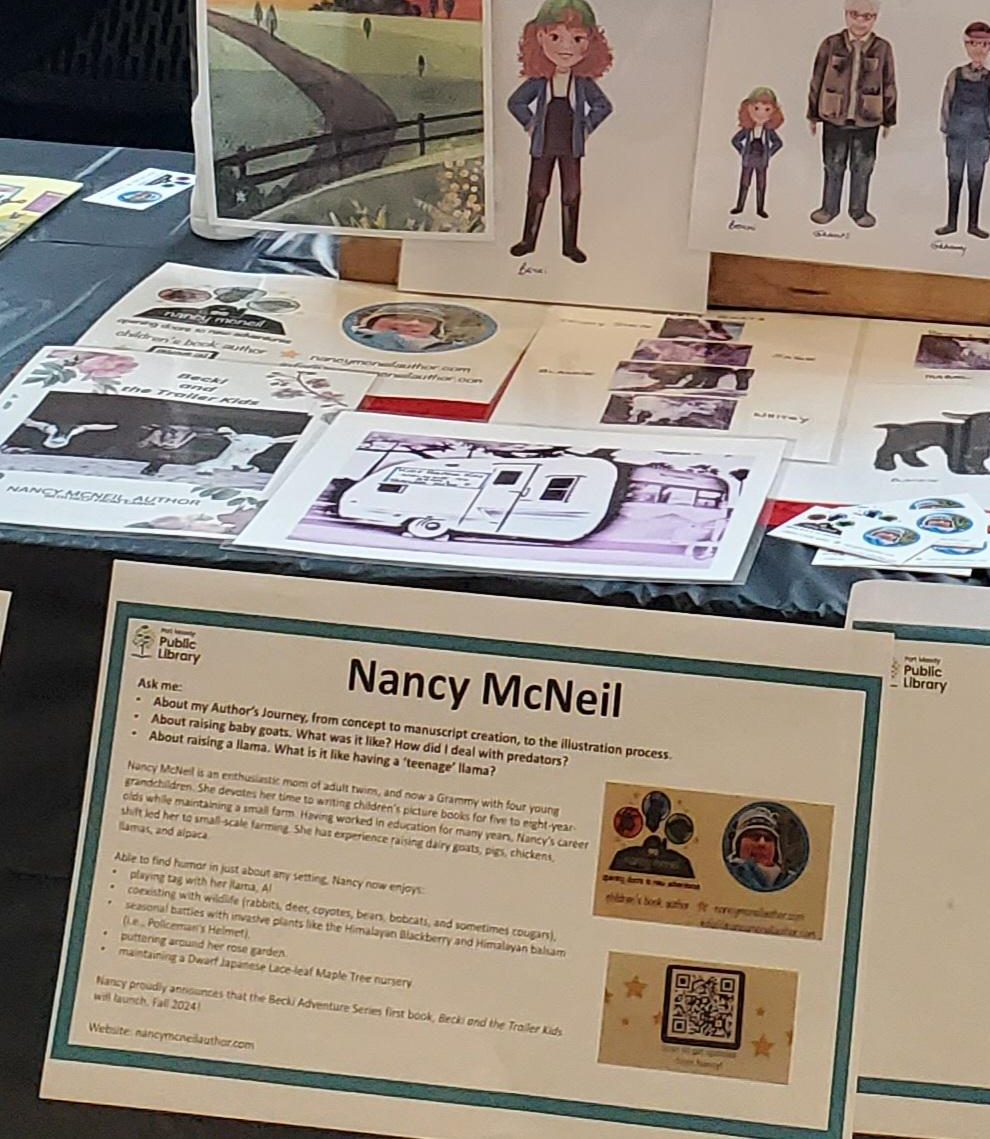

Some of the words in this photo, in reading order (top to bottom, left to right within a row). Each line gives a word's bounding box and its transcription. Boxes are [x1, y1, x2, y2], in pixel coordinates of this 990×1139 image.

[214, 317, 266, 328] mcneil
[115, 329, 181, 345] children's
[183, 339, 216, 348] book
[221, 343, 268, 355] author
[176, 372, 229, 385] Becki
[178, 382, 219, 393] and
[120, 385, 152, 395] the
[157, 388, 217, 403] Trailer
[219, 397, 261, 407] Kids
[6, 485, 66, 496] NANCY
[132, 494, 201, 507] AUTHOR
[160, 636, 197, 650] Public
[157, 648, 201, 666] Library
[904, 664, 943, 678] Public
[137, 677, 159, 690] Ask
[349, 658, 471, 711] Nancy
[483, 672, 622, 718] McNeil
[903, 676, 948, 694] Library
[153, 696, 188, 710] About
[191, 702, 209, 714] my
[211, 702, 260, 717] Author's
[312, 712, 339, 726] from
[342, 718, 386, 732] concept
[389, 722, 401, 732] to
[404, 725, 468, 741] manuscript
[524, 736, 536, 746] to
[539, 736, 559, 749] the
[561, 738, 623, 755] illustration
[151, 713, 187, 727] About
[189, 718, 226, 734] raising
[228, 720, 257, 736] baby
[296, 728, 327, 742] What
[330, 734, 352, 745] was
[354, 734, 363, 746] it
[365, 735, 392, 748] like?
[394, 739, 421, 752] How
[423, 742, 442, 754] did
[444, 743, 449, 755] I
[451, 744, 476, 757] deal
[478, 748, 504, 761] with
[506, 752, 569, 767] predators?
[149, 730, 184, 744] About
[187, 735, 225, 751] raising
[226, 740, 233, 749] a
[274, 743, 305, 757] What
[307, 746, 317, 758] is
[319, 747, 328, 760] it
[330, 748, 350, 762] like
[353, 751, 391, 768] having
[393, 758, 400, 767] a
[403, 756, 456, 774] 'teenage'
[458, 762, 497, 777] llama?
[130, 869, 166, 884] playing
[167, 874, 183, 887] tag
[185, 876, 208, 886] with
[210, 877, 228, 888] her
[261, 883, 273, 894] Al
